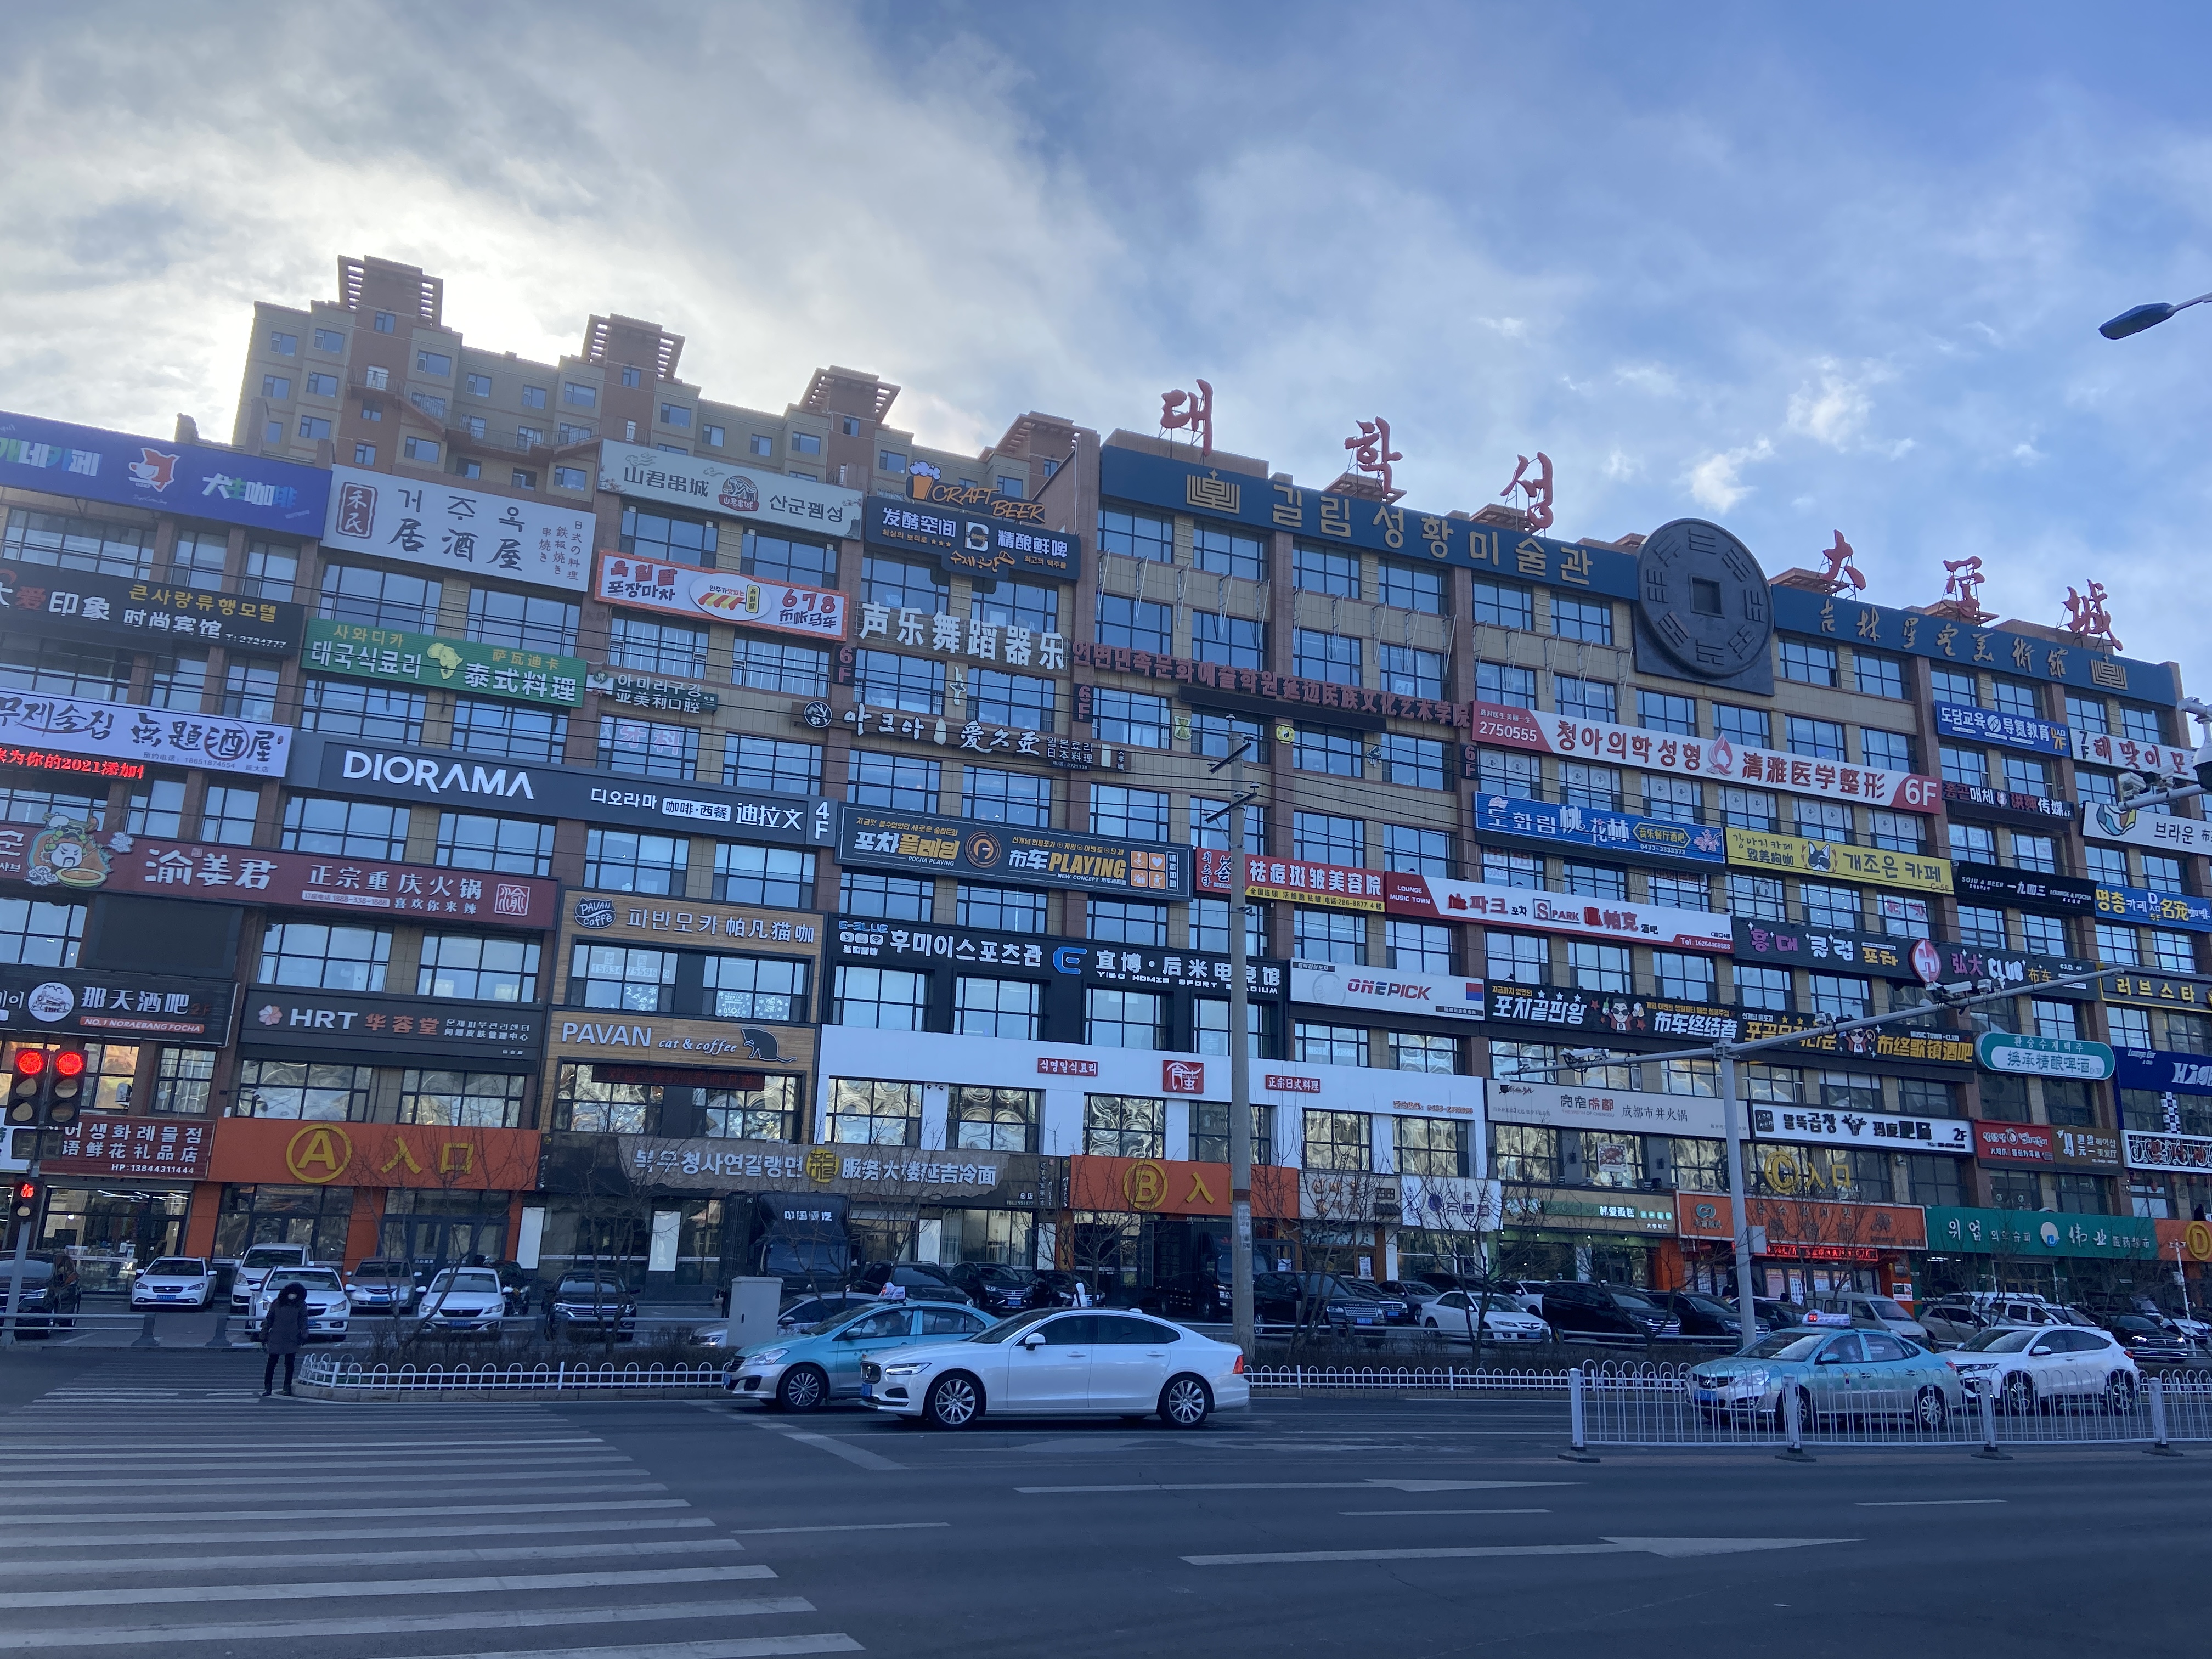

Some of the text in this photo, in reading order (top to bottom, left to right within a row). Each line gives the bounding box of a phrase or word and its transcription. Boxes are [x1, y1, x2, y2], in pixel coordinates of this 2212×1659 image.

[624, 467, 709, 498] 山君串城
[398, 489, 525, 532] 거주옥
[723, 498, 754, 511] 山君串城
[933, 485, 1046, 523] CRAFT BEER
[883, 507, 956, 538] 发酵空间
[1273, 485, 1593, 586] 길림성황미술관
[388, 518, 522, 572] 居酒屋
[539, 527, 551, 562] 串焼き
[567, 521, 582, 580] 日式の料理
[997, 529, 1068, 558] 精酿鲜啤
[129, 584, 277, 623] 큰사랑류행모텔
[608, 580, 675, 601] 포장마차
[782, 589, 836, 613] 678
[123, 608, 222, 639] 时尚宾馆
[779, 609, 837, 628] 布帐马车
[334, 625, 404, 648] 사와디카
[859, 602, 1064, 670] 声乐舞蹈器乐
[311, 641, 421, 678] 태국식료리
[493, 648, 560, 670] 萨瓦迪卡
[838, 646, 853, 683] 6F
[1073, 640, 1278, 697] 연변민족문화예술학원
[464, 663, 576, 701] 泰式料理
[618, 674, 702, 697] 아미리구강
[615, 688, 701, 714] 亚美利口腔
[1282, 675, 1470, 729] 延边民族文化艺术学院
[1479, 721, 1537, 742] 2750555
[1941, 707, 1985, 729] 도담교육
[1047, 736, 1093, 752] 일본료리
[1047, 748, 1093, 764] 日本料理
[1556, 720, 1701, 771] 청아의학성형
[185, 758, 235, 768] 18651874554
[342, 750, 535, 799] DIORAMA
[1464, 745, 1476, 777] 6F
[1742, 751, 1885, 798] 清雅医学整形
[590, 787, 657, 810] 디오라마
[1904, 778, 1937, 806] 6F
[735, 803, 803, 831] 迪拉文
[854, 831, 960, 860] 포차플레잉
[1639, 827, 1685, 844] 音乐餐厅酒吧
[1733, 833, 1793, 850] 강아지 카페
[2154, 821, 2194, 844] 브라운
[145, 849, 277, 890] 渝姜君
[1008, 849, 1126, 879] 布车 PLAYING
[1250, 860, 1381, 896] 祛痘斑皱美容院
[1843, 851, 1941, 881] 개조은 카페
[307, 864, 482, 901] 正宗重庆火锅
[1250, 888, 1278, 898] 全国连锁
[1397, 885, 1423, 894] LOUNGE
[394, 897, 477, 915] 喜欢你来辣
[579, 901, 611, 913] PAVAN
[1390, 893, 1410, 902] MUSIC
[1511, 906, 1527, 917] 포차
[627, 909, 815, 944] 파반모카 帕凡猫咖
[890, 930, 1042, 967] 후미이스포츠관
[1751, 929, 1798, 952] 홍대
[1810, 936, 1853, 961] 클럽
[1951, 953, 1983, 976] 弘大
[1097, 971, 1125, 979] YIBO
[1178, 979, 1217, 988] SPORT
[1226, 984, 1278, 994] SDIUM
[1347, 978, 1432, 1000] ONEPICK
[2117, 978, 2194, 1003] 러브스타
[81, 987, 189, 1014] 那天酒吧
[1493, 995, 1587, 1025] 포차끝판왕
[109, 1020, 167, 1030] NORAEBANG
[290, 1008, 358, 1029] HRT
[365, 1013, 440, 1035] 华容堂
[1654, 1011, 1737, 1039] 布车终结者
[444, 1028, 528, 1041] 问题皮肤管理中心
[562, 1022, 737, 1056] PAVAN cat & coffee
[1877, 1035, 1973, 1062] 布终歌镇酒吧
[1039, 1059, 1097, 1076] 식영일식료리
[1268, 1077, 1319, 1092] 正宗日式料理
[1622, 1105, 1688, 1122] 成都市井火锅
[380, 1137, 475, 1176] 入口
[634, 1149, 803, 1178] 복무청사연길랭면
[842, 1158, 996, 1186] 服务大楼延吉冷面
